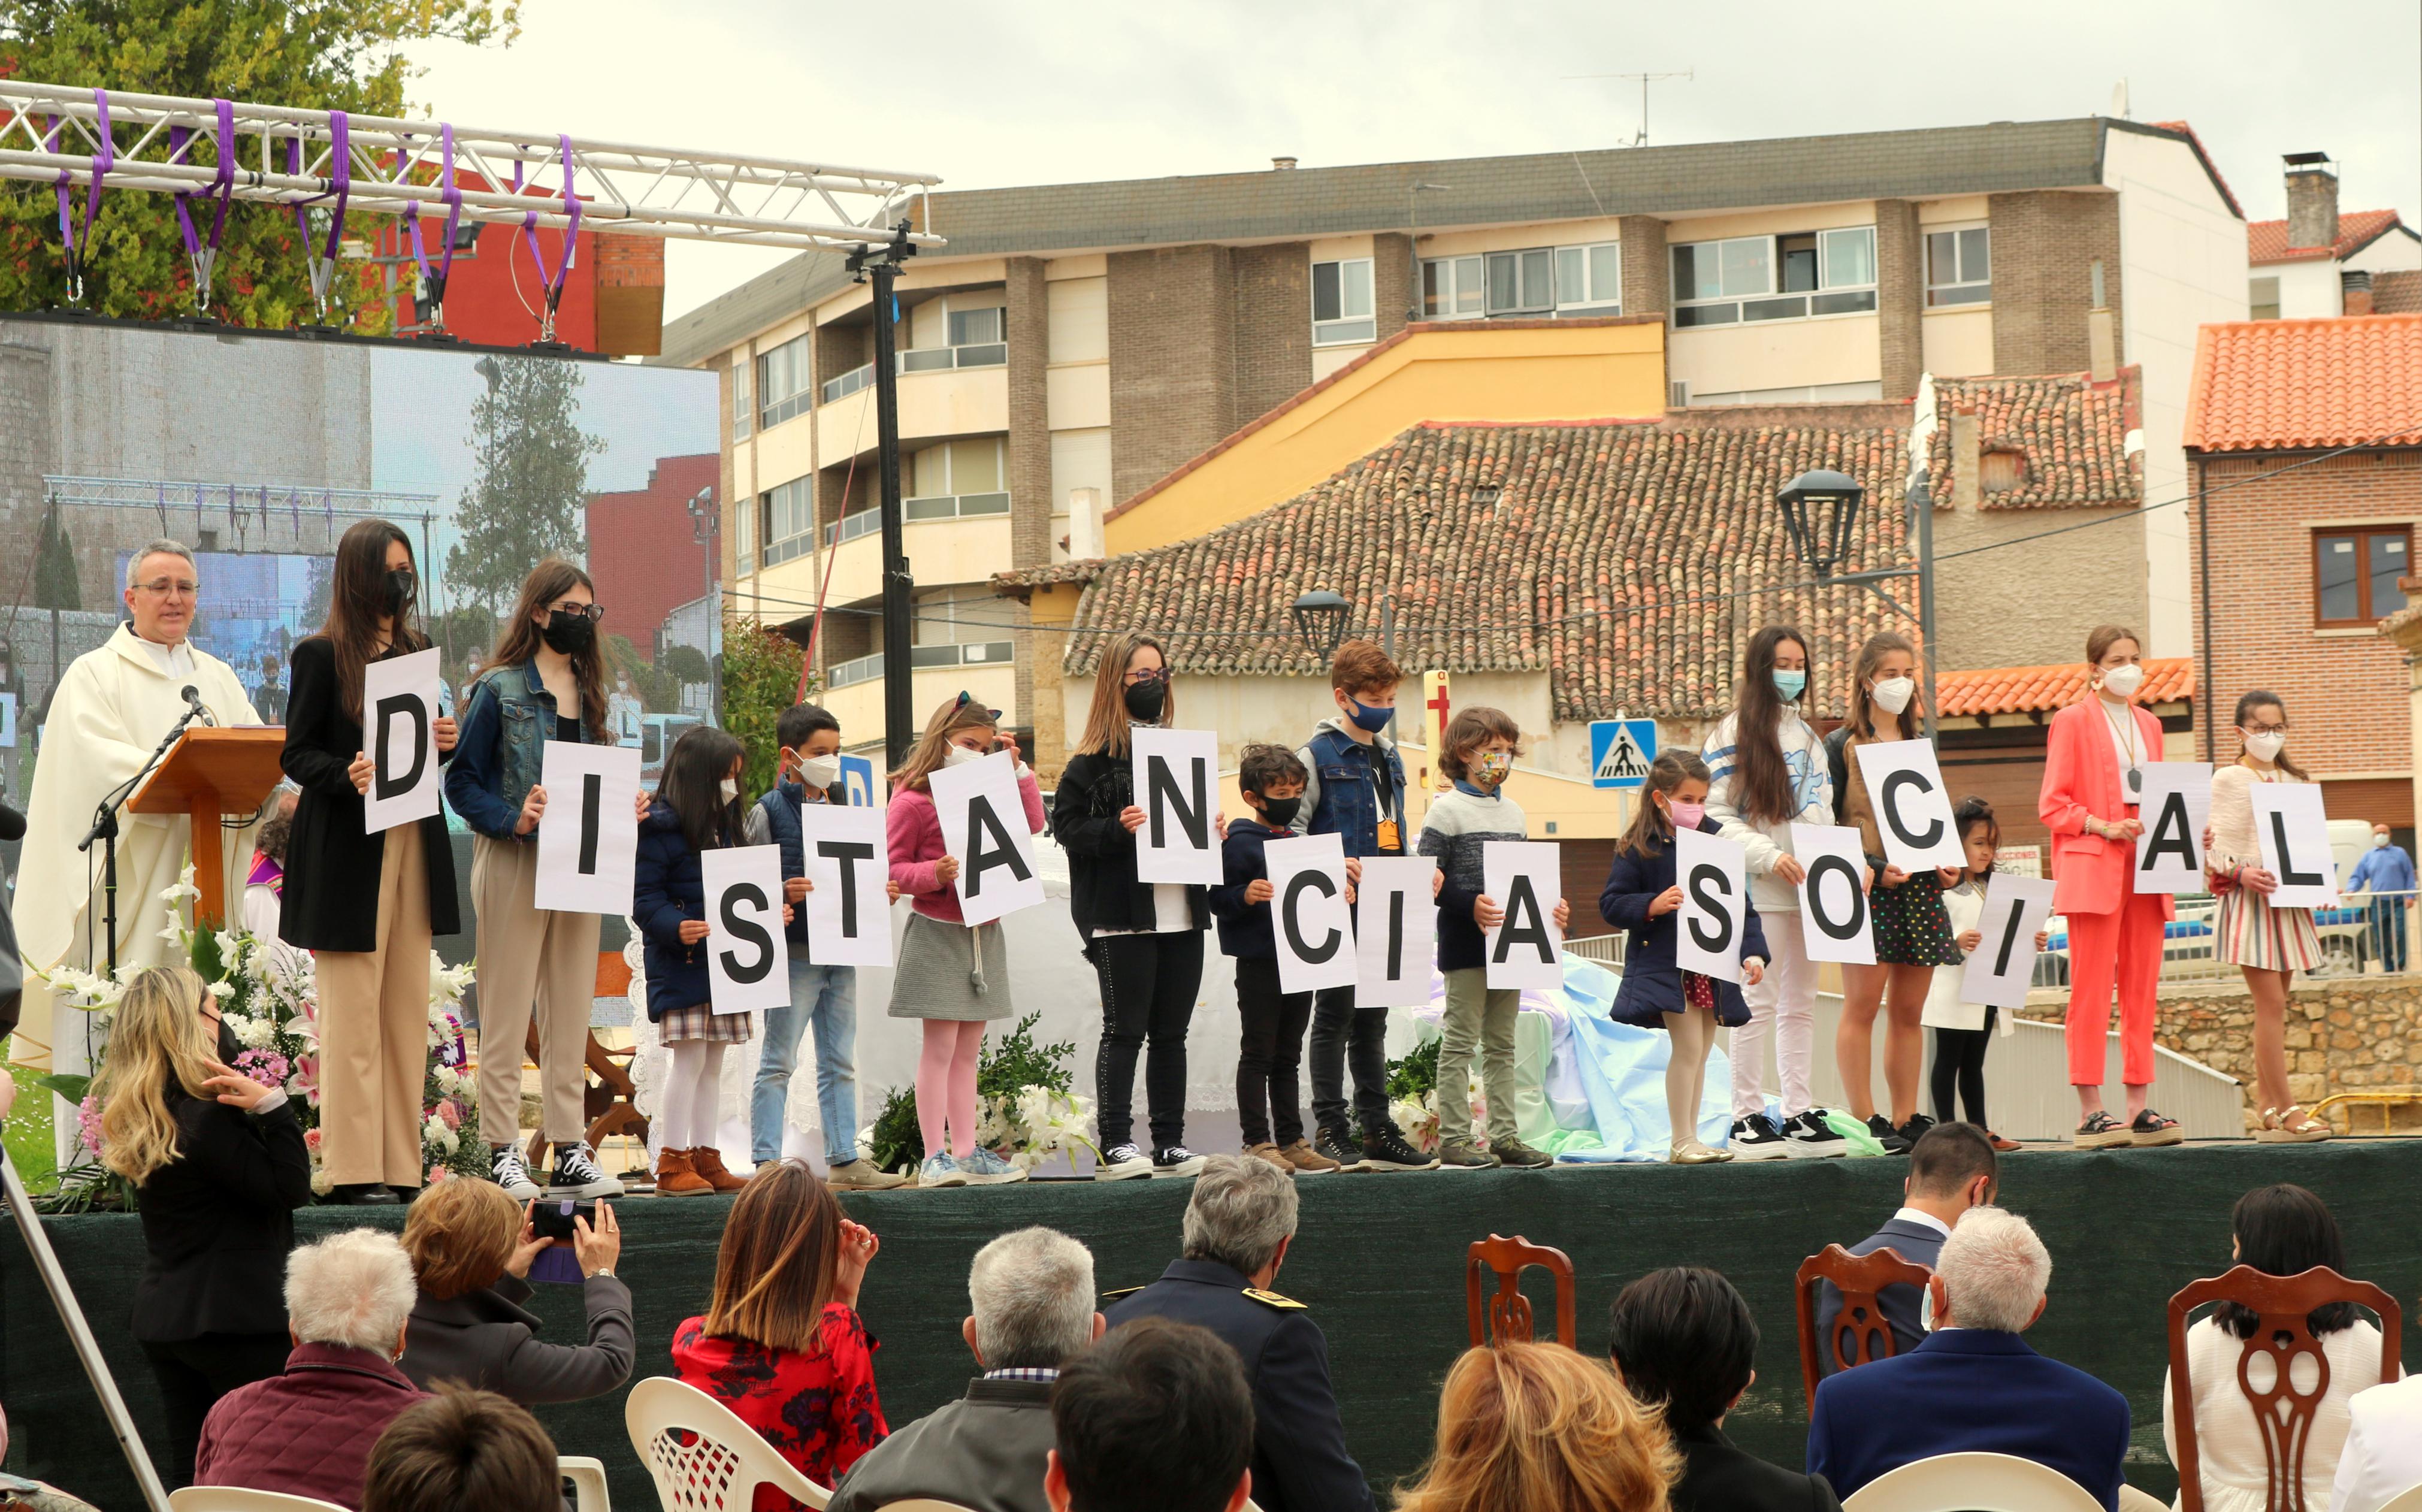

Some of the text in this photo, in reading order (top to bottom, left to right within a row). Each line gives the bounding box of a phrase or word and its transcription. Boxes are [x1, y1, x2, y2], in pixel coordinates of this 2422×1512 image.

[375, 694, 428, 801] D
[579, 774, 600, 875] I
[966, 795, 1032, 899] A
[1148, 756, 1208, 849] N
[1882, 770, 1943, 849] C
[2141, 793, 2197, 870] A
[817, 841, 873, 938] T
[2270, 812, 2323, 885] L
[720, 883, 774, 984] S
[1283, 870, 1341, 964] C
[1387, 891, 1403, 980] I
[1492, 875, 1555, 963] A
[1688, 864, 1732, 953] S
[1807, 855, 1864, 939] O
[1994, 899, 2025, 976] I
